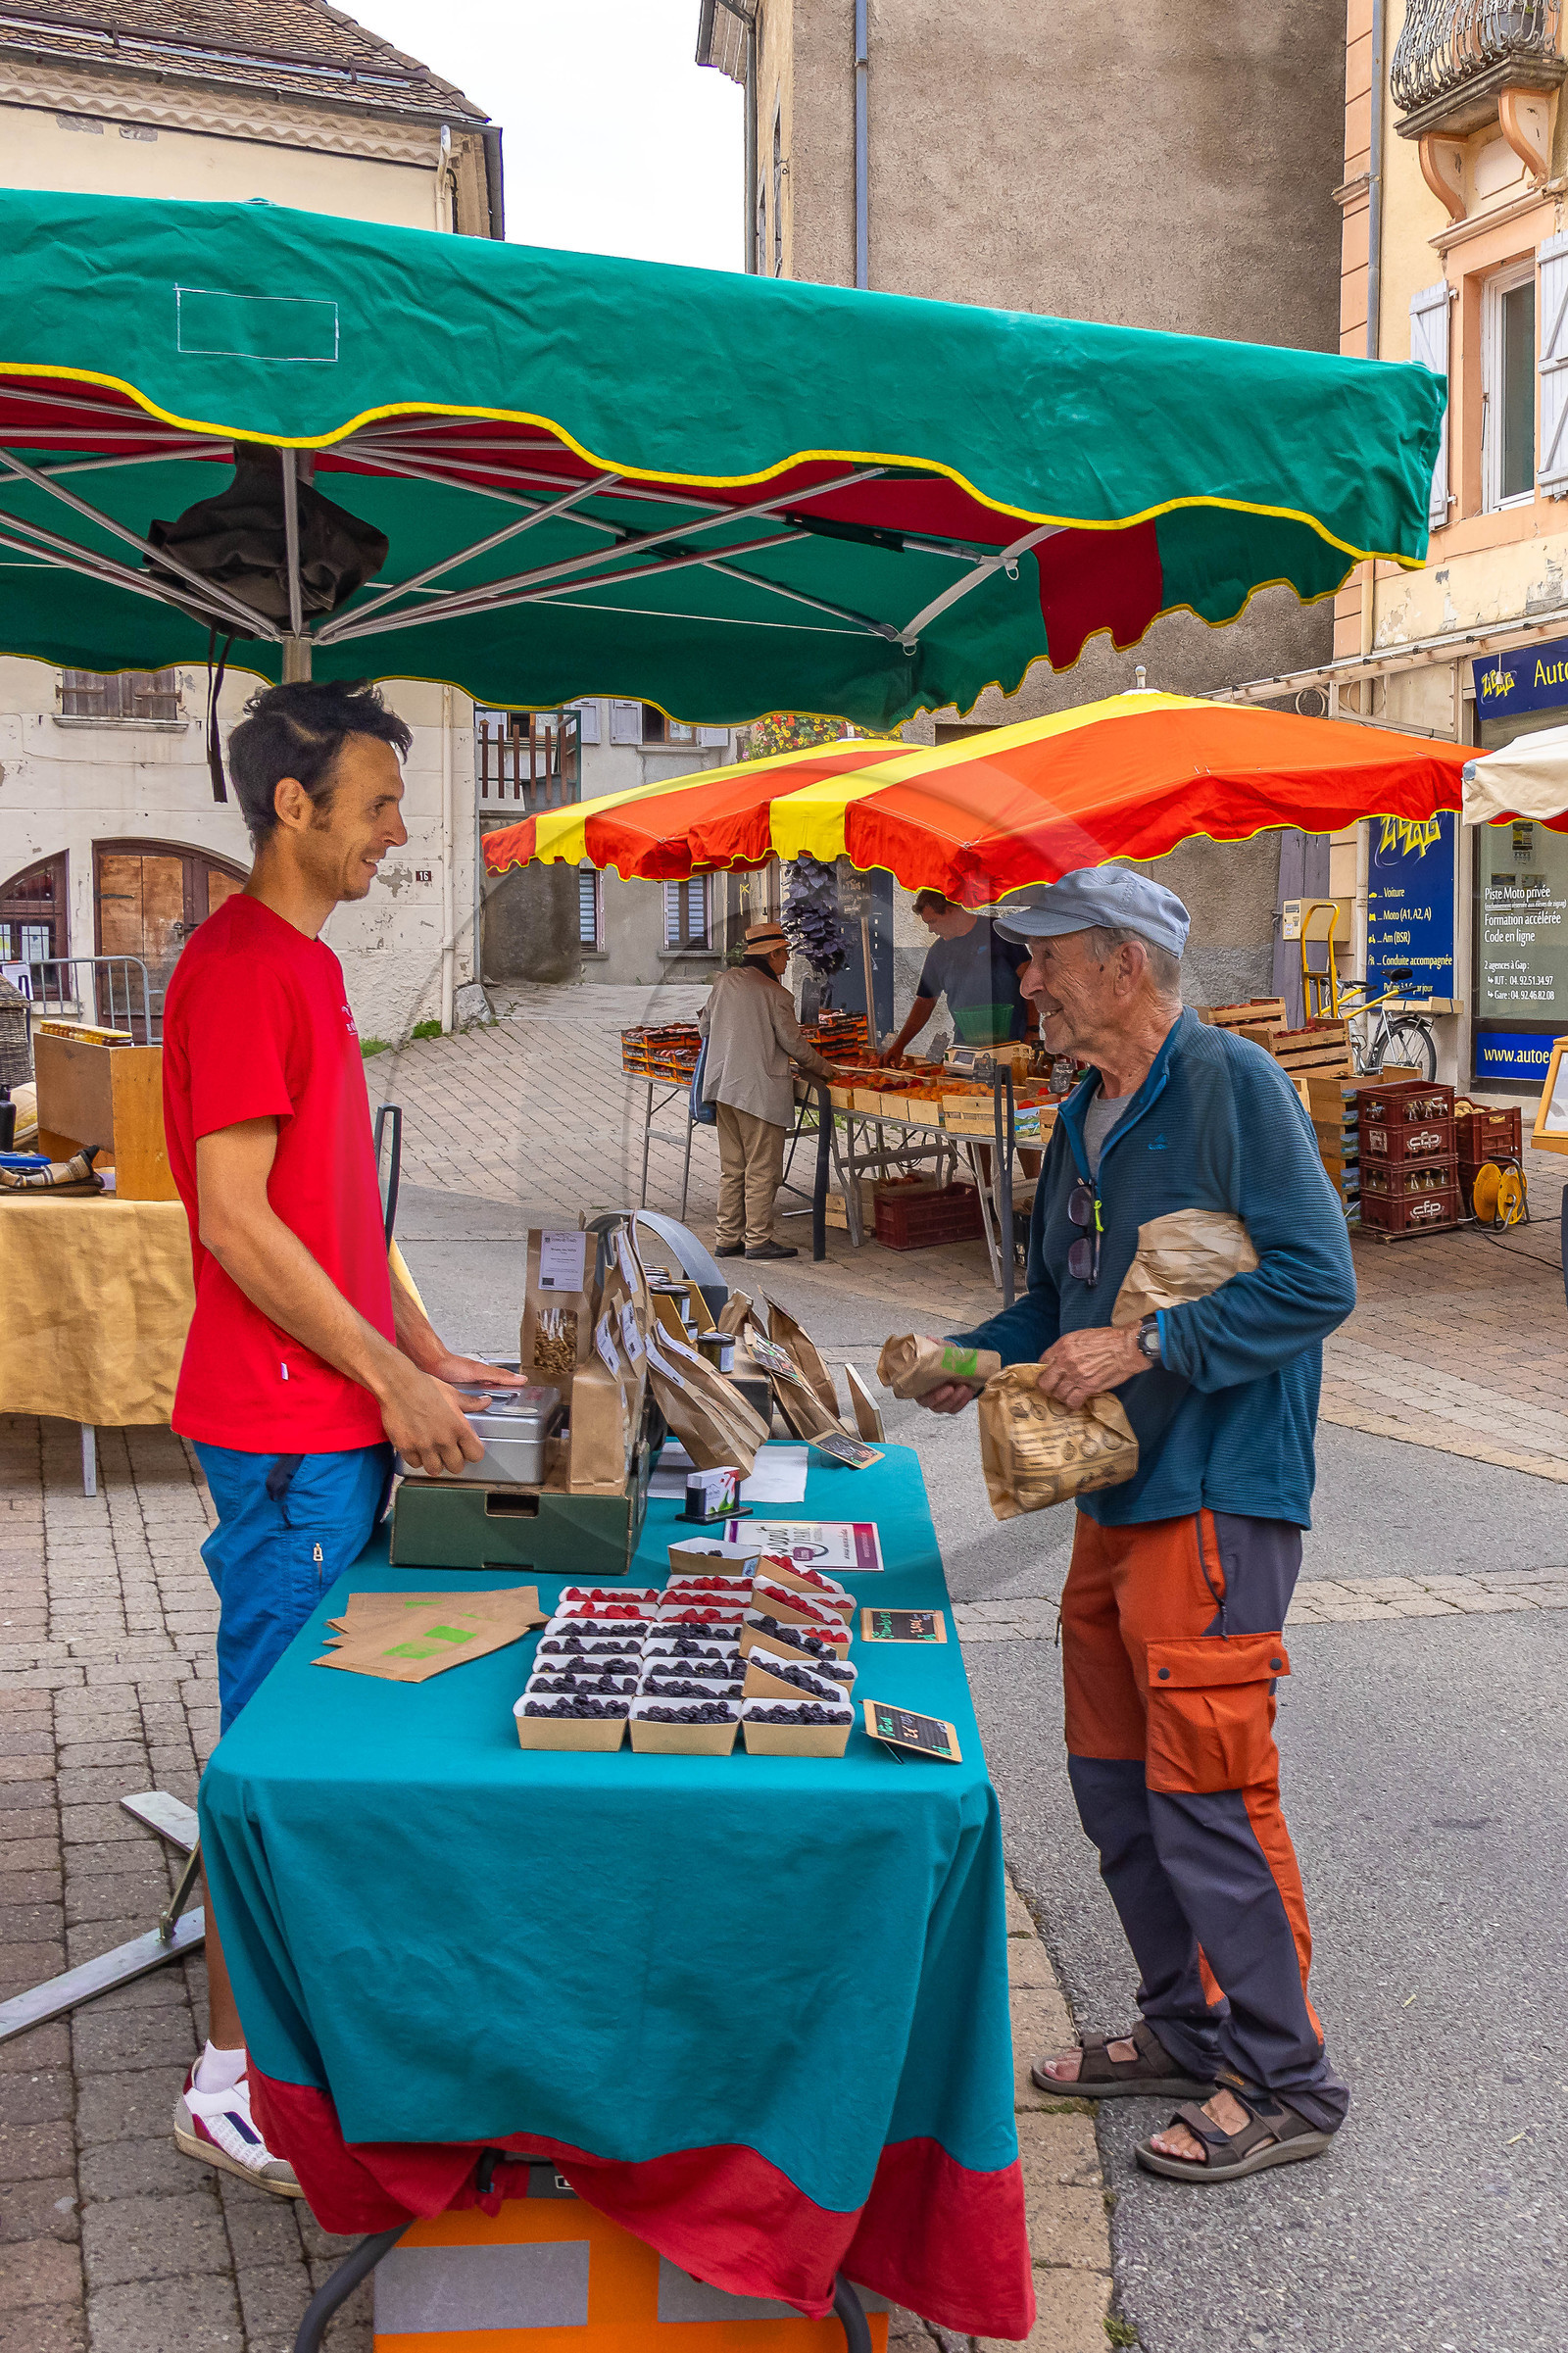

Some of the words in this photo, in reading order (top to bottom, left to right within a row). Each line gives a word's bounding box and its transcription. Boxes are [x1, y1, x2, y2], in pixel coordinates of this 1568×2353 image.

[419, 871, 429, 881] 16
[1383, 887, 1405, 898] Voiture
[1485, 887, 1503, 901] Piste
[1503, 886, 1525, 900] Moto
[1526, 884, 1551, 903] privée
[1384, 909, 1399, 920] Moto
[1399, 907, 1412, 922] (A1,
[1412, 907, 1424, 920] A2,
[1424, 907, 1432, 921] A)
[1485, 912, 1524, 926] Formation
[1525, 909, 1561, 924] accélérée
[1383, 932, 1394, 943] Am
[1394, 931, 1411, 946] (BSR)
[1485, 928, 1504, 943] Code
[1505, 932, 1515, 942] en
[1516, 927, 1536, 947] ligne
[1382, 954, 1409, 966] Conduite
[1409, 954, 1453, 970] accompagnée
[1484, 959, 1489, 970] 2
[1489, 961, 1510, 973] agences
